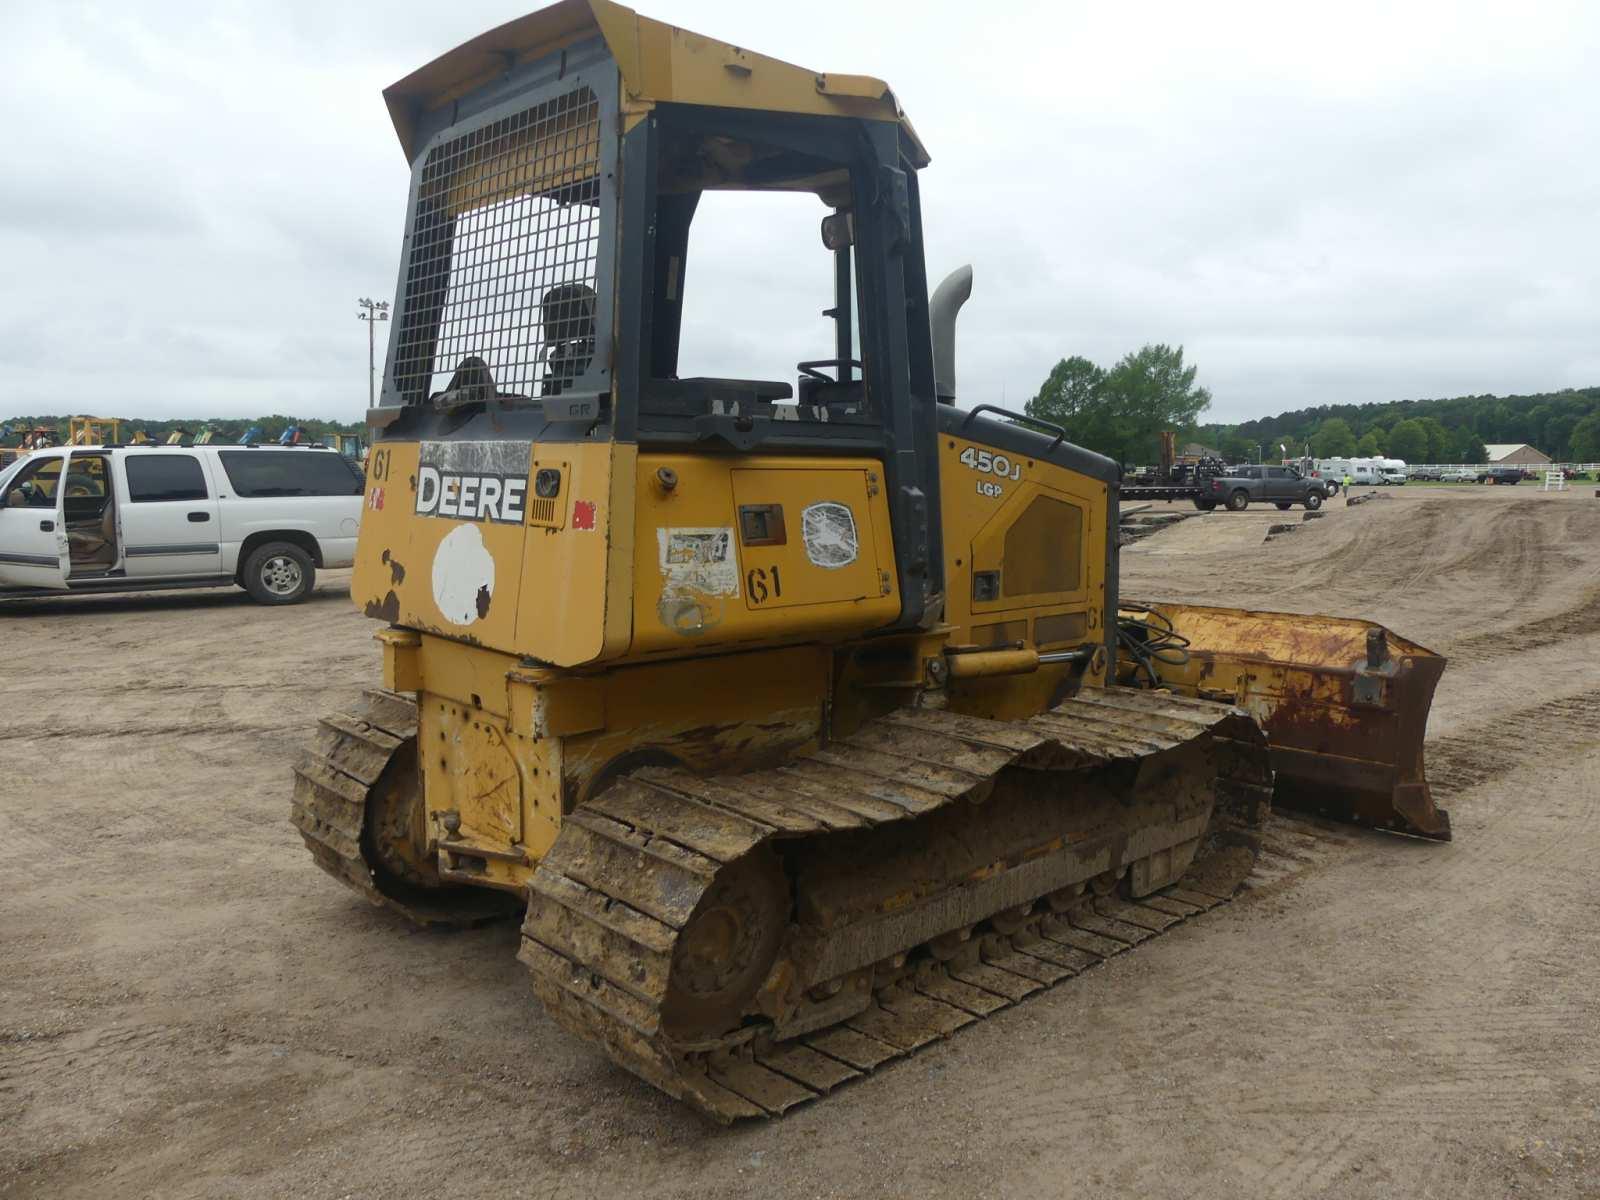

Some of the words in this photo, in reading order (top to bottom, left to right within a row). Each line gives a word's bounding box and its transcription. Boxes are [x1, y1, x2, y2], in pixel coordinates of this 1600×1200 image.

[373, 449, 391, 481] 61
[960, 447, 1020, 480] 450J
[416, 466, 526, 521] DEERE
[977, 480, 1003, 497] LGP
[748, 565, 781, 604] 61
